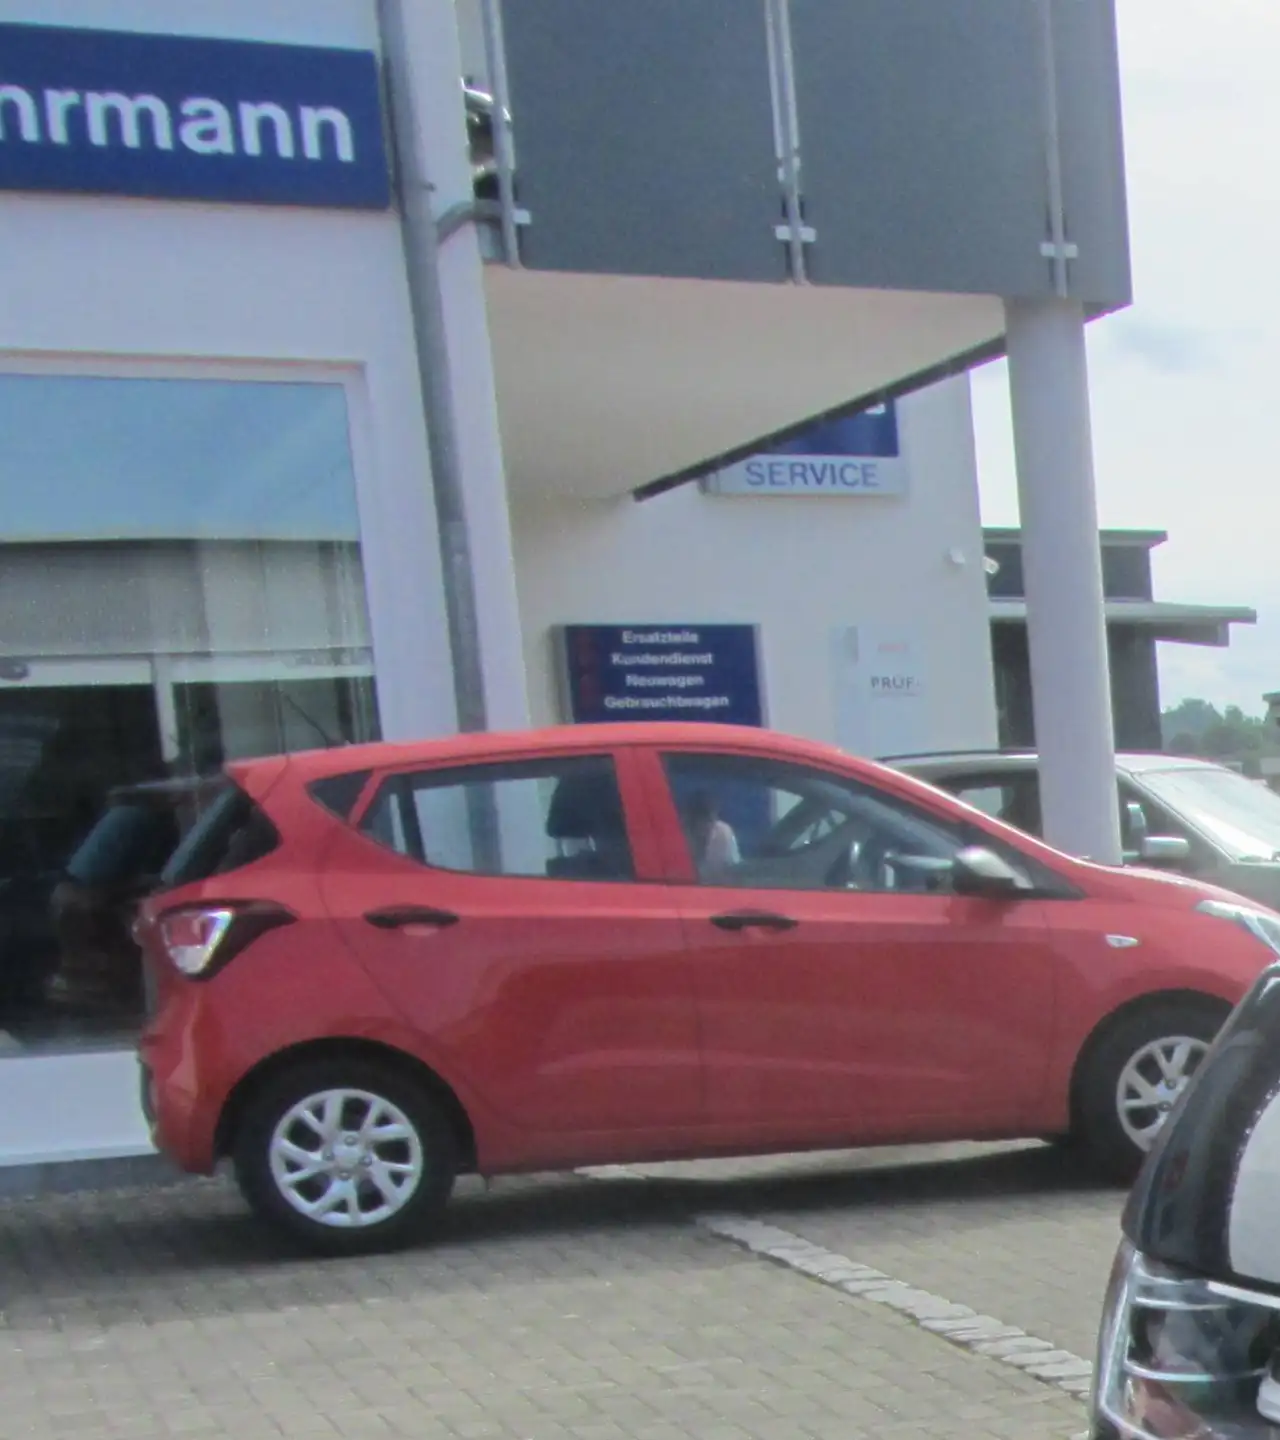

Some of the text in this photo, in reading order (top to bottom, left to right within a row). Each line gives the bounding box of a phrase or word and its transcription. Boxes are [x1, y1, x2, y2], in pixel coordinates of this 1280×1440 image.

[745, 462, 879, 487] SERVICE
[622, 630, 699, 644] Ersatzteile
[611, 652, 714, 666] Kundendienst
[625, 674, 704, 688] Neuwagen
[604, 696, 729, 709] Gebrauchtwagen
